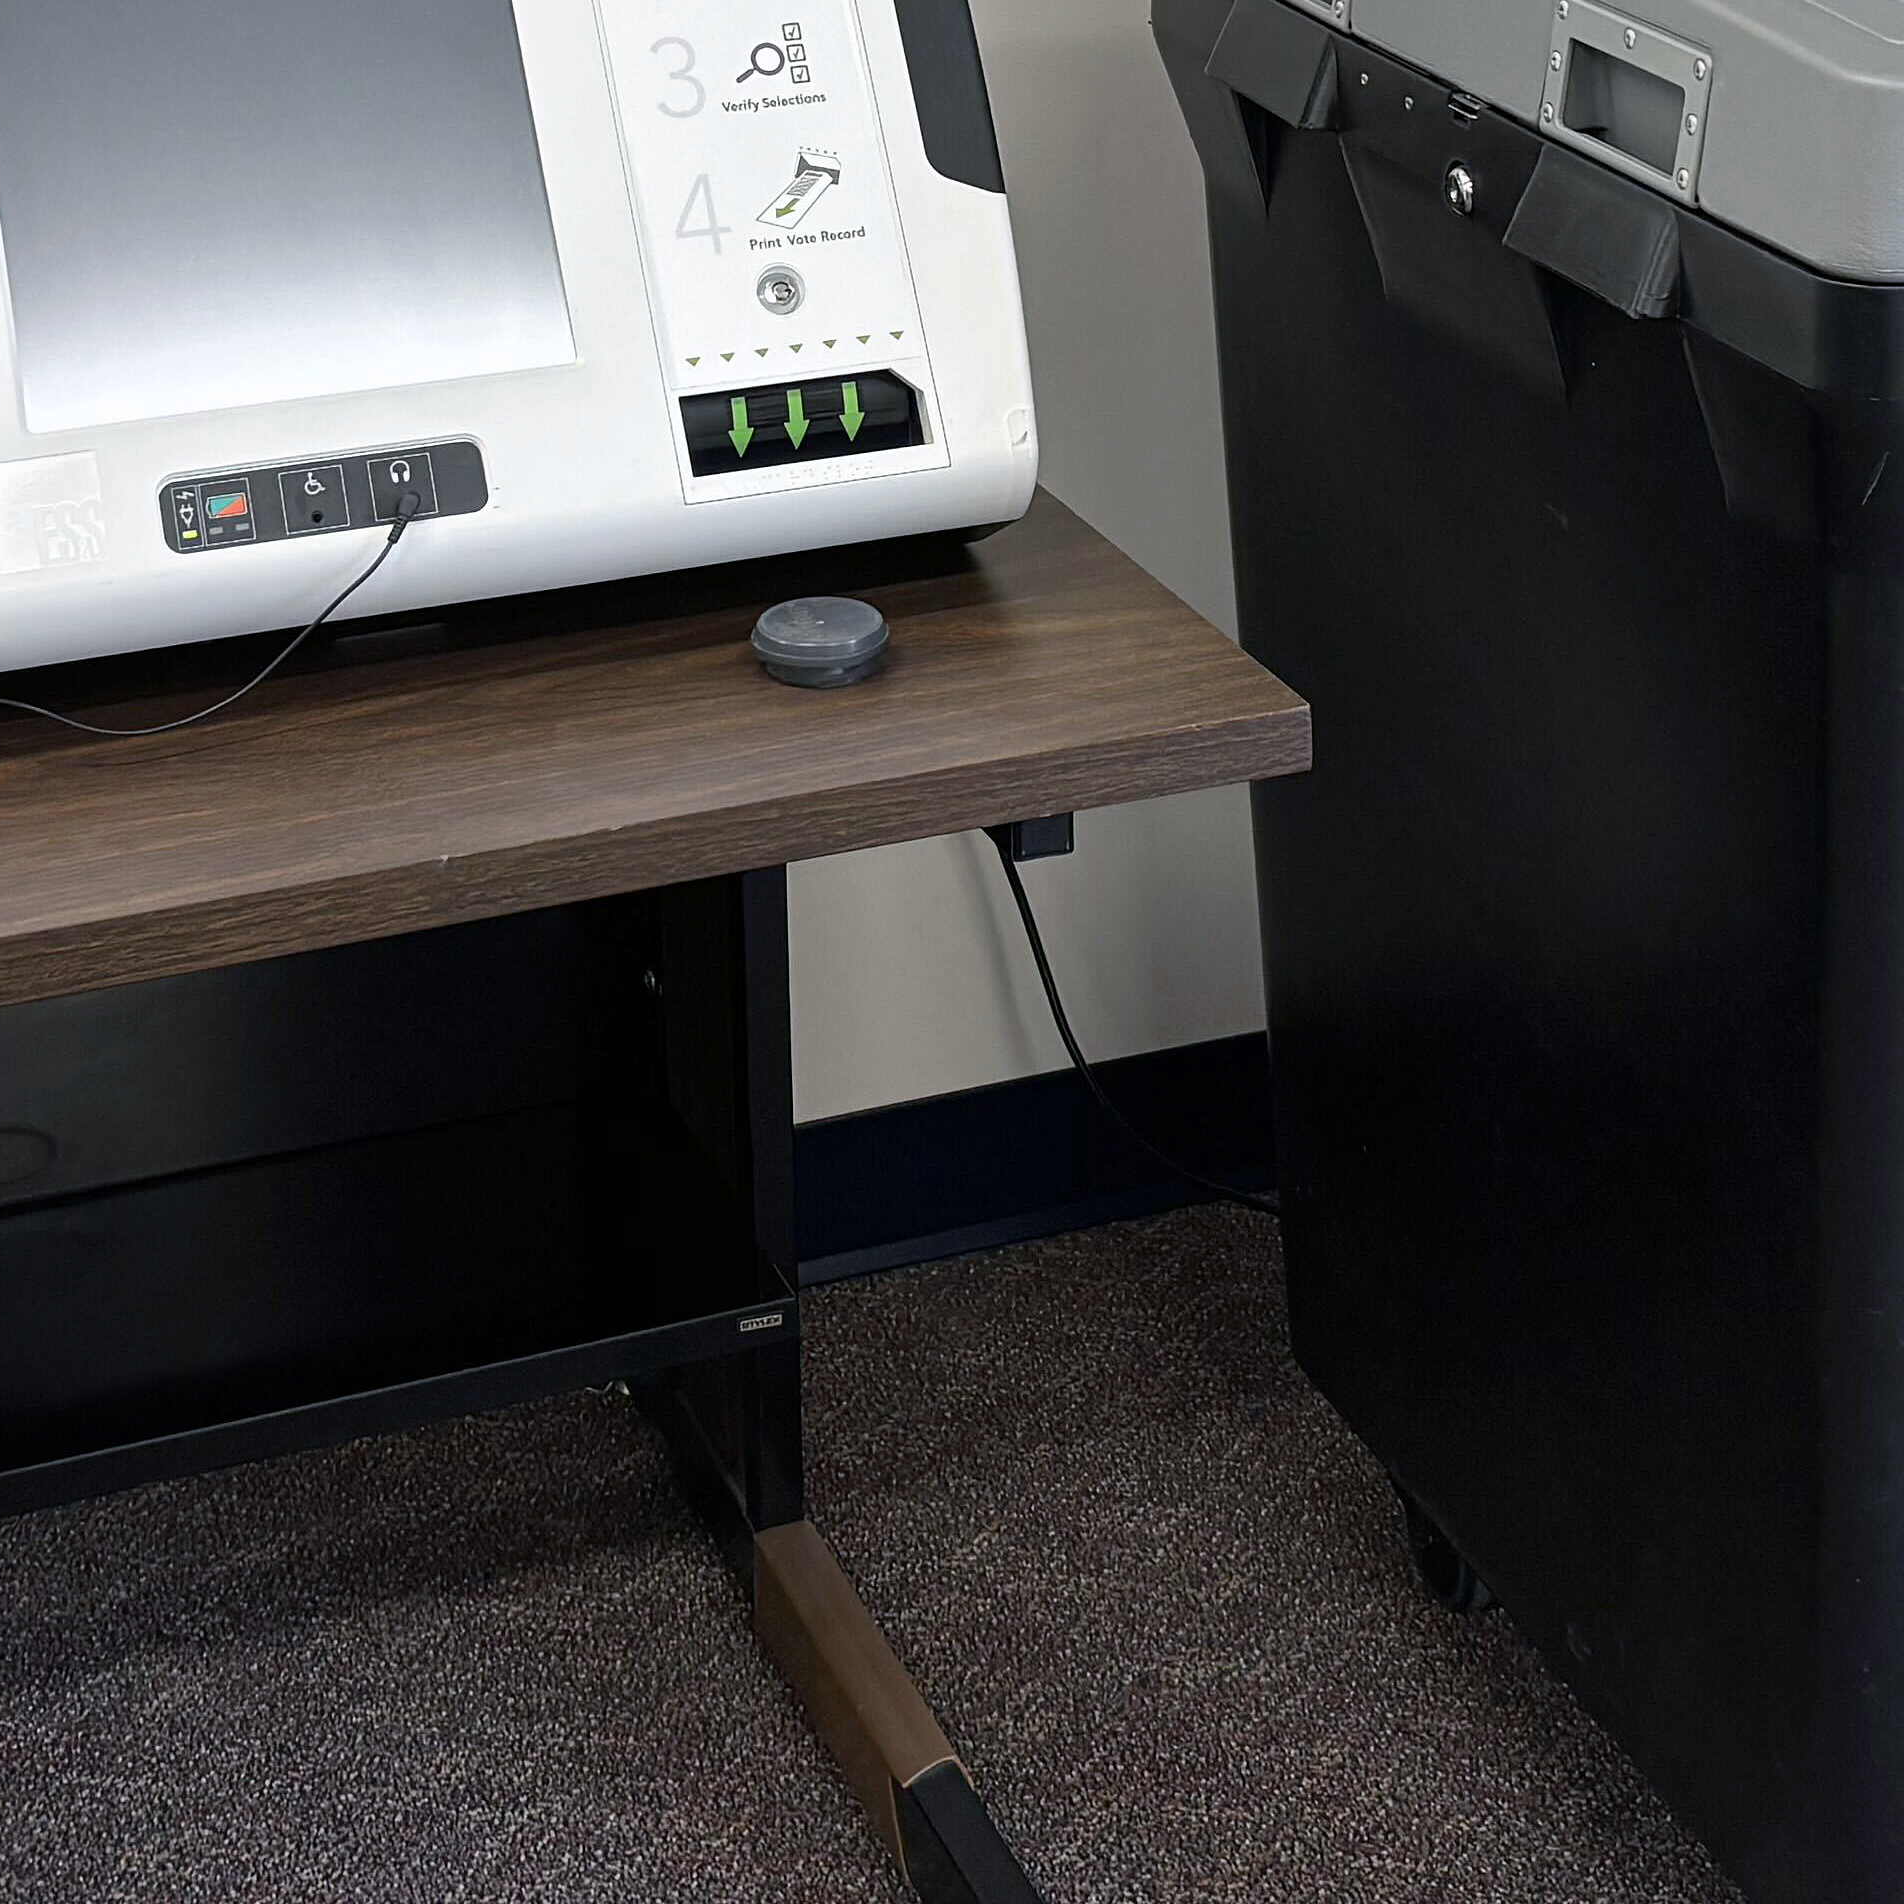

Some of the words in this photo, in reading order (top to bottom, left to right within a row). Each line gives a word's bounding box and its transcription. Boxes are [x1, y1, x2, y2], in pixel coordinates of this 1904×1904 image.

[649, 36, 706, 119] 3
[721, 98, 760, 112] Verify
[761, 92, 827, 109] Selections
[675, 173, 732, 255] 4
[749, 236, 782, 251] Print
[786, 234, 817, 246] Vote
[821, 226, 866, 242] Record
